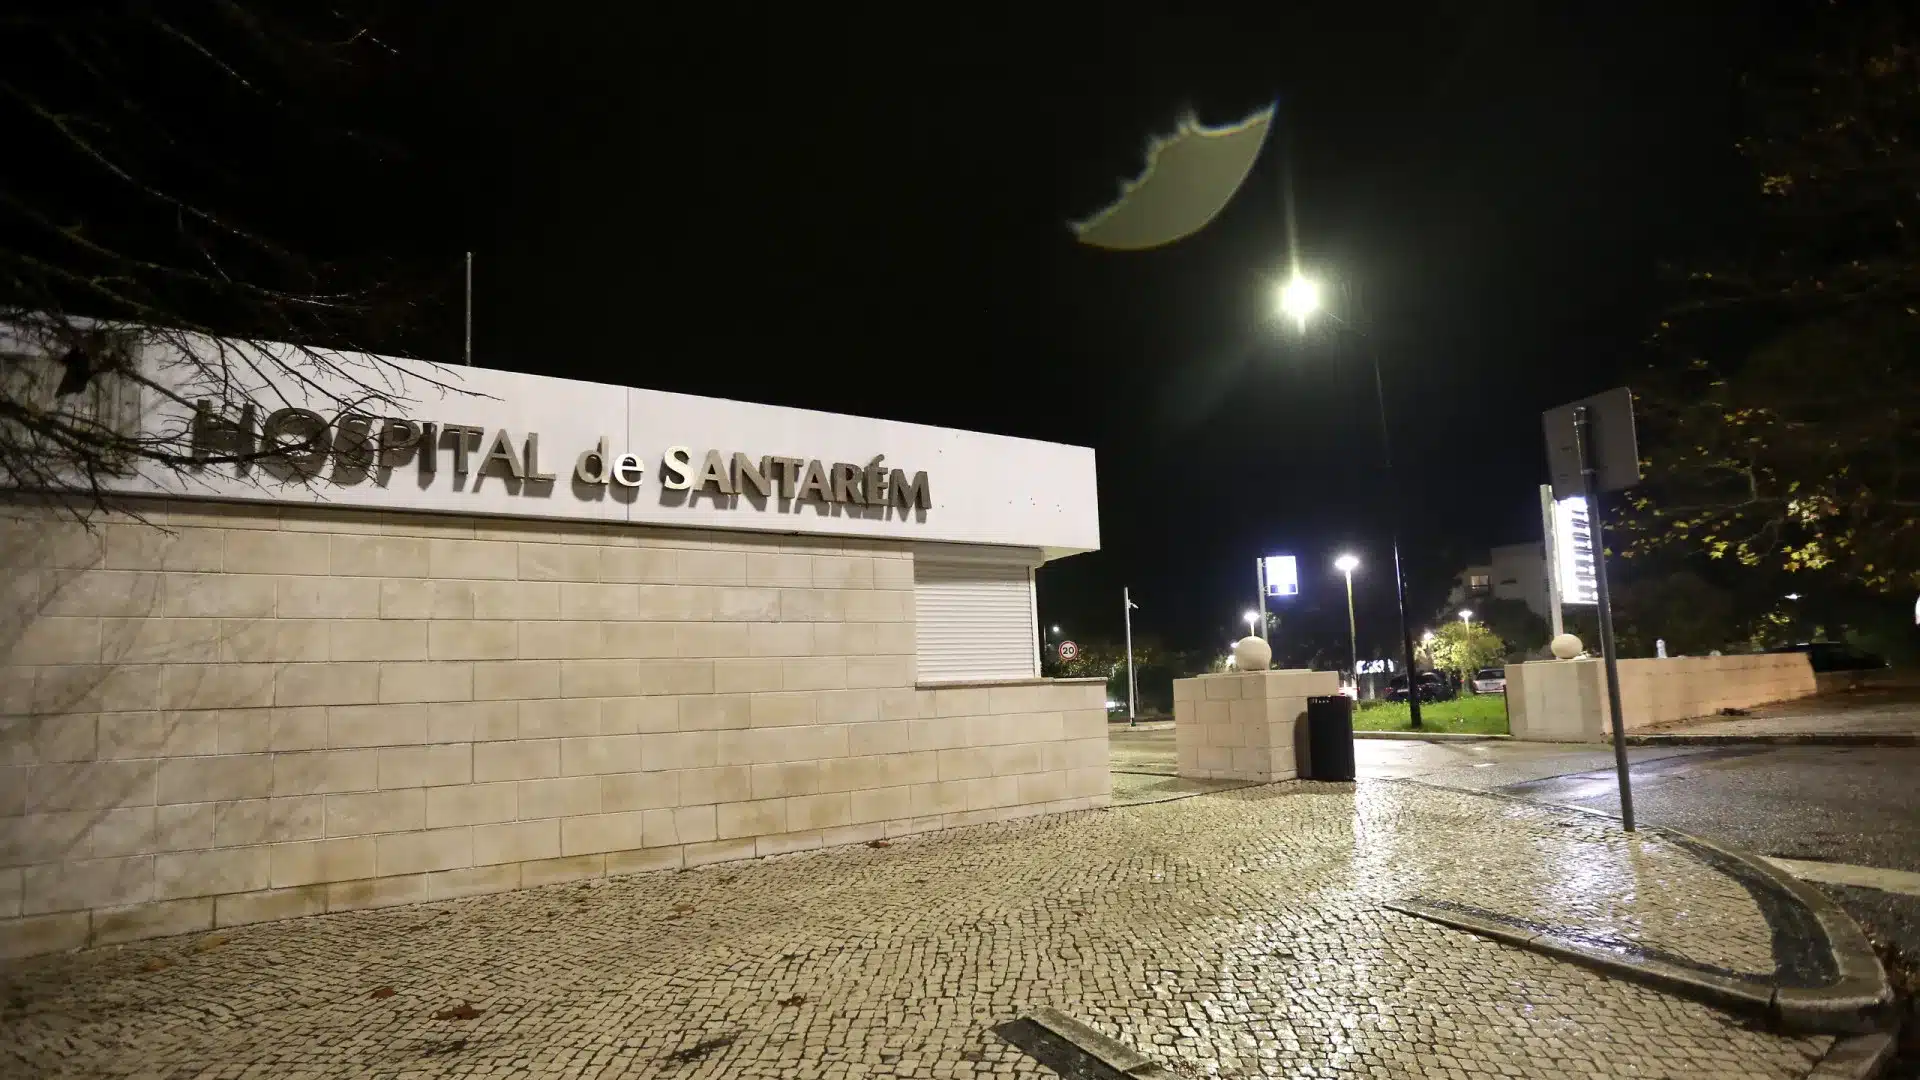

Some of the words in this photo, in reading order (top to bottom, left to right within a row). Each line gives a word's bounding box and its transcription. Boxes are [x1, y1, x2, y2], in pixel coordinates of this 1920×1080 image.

[193, 399, 556, 482] HOSPITAL
[576, 436, 644, 488] de
[663, 445, 932, 510] SANTARÉM
[1062, 646, 1075, 655] 20
